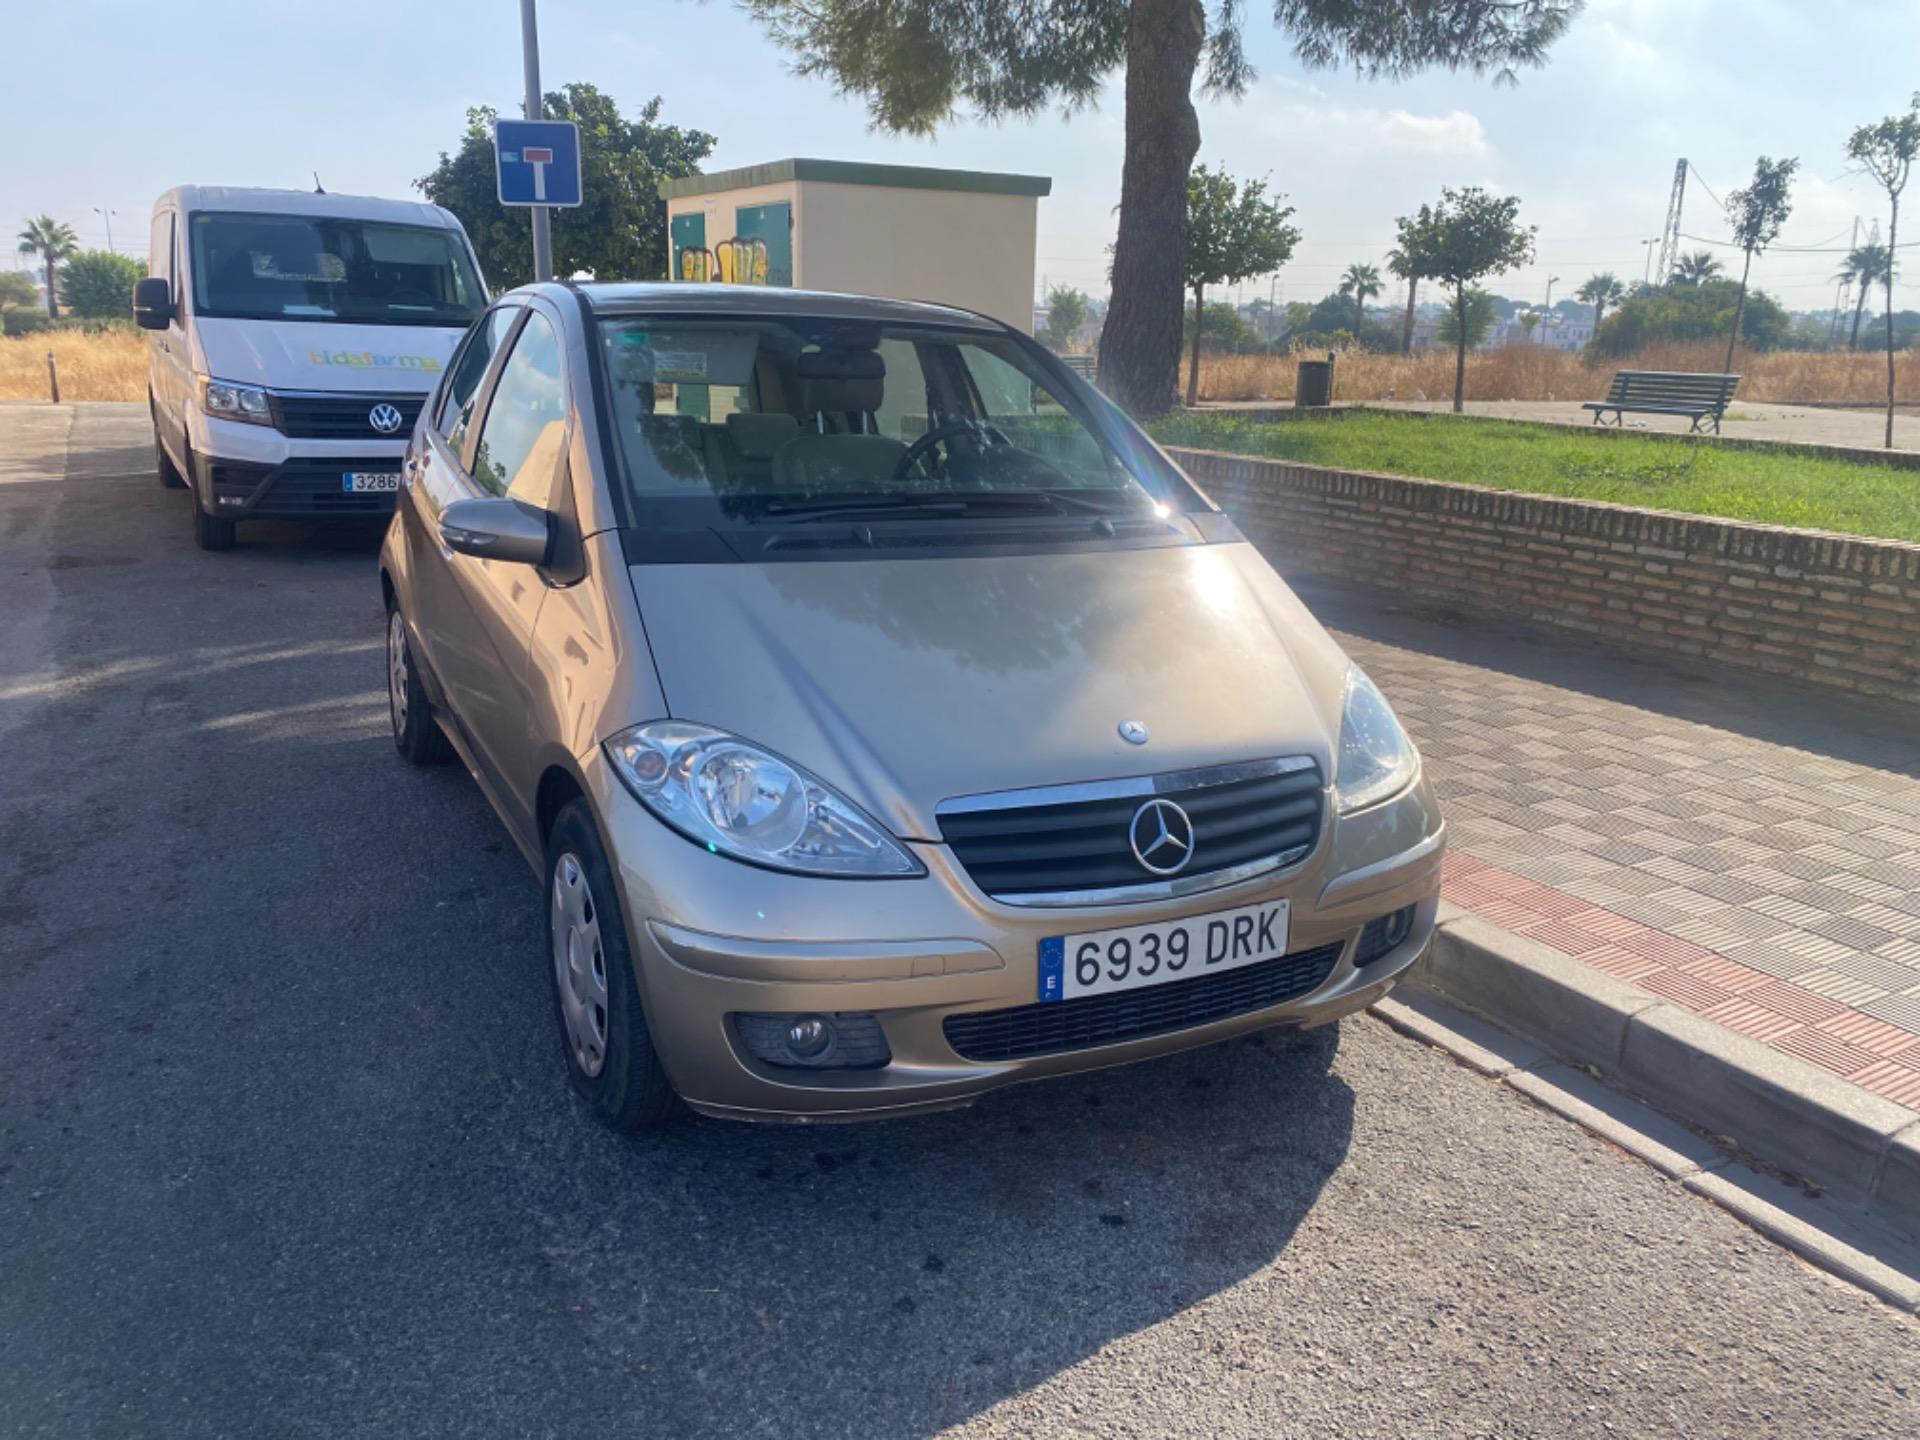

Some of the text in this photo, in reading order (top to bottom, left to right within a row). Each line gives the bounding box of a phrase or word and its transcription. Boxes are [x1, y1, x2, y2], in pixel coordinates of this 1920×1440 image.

[356, 475, 397, 490] 3286
[1046, 908, 1280, 989] E 6939 DRK
